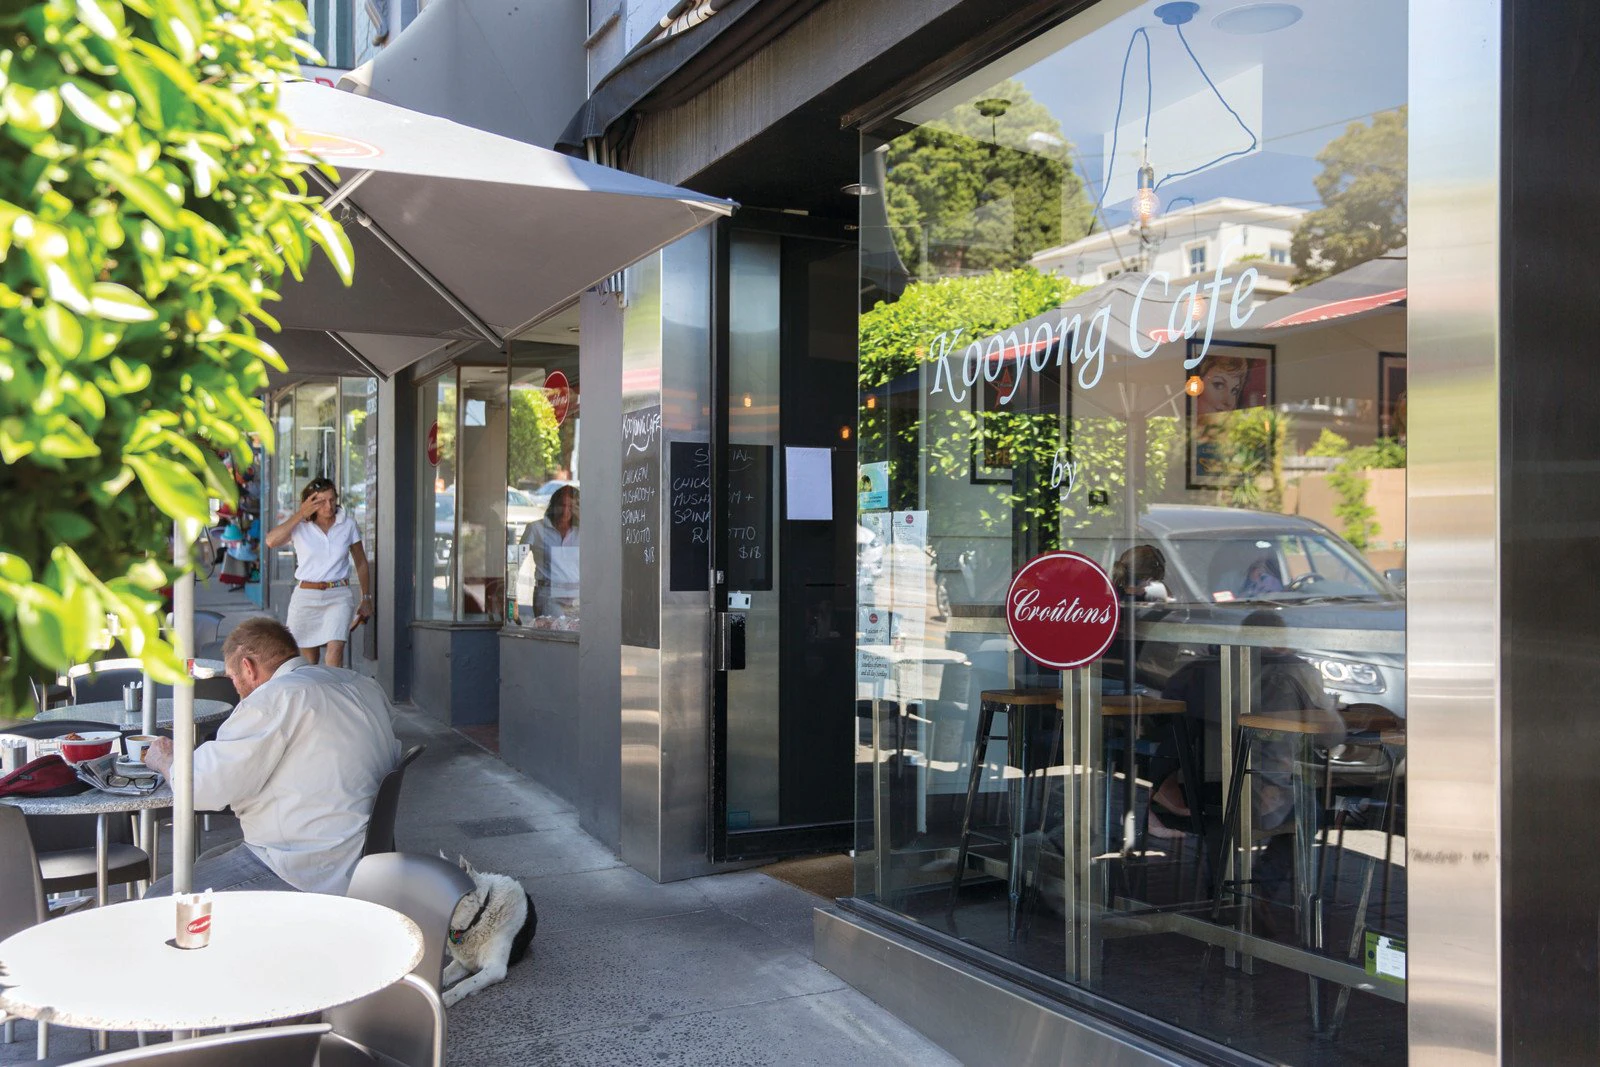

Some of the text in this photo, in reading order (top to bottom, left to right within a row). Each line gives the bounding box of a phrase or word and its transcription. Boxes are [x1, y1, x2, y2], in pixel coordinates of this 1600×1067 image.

[930, 235, 1259, 405] Kooyong Cafe
[1051, 448, 1077, 500] by
[739, 545, 762, 560] $18
[1013, 588, 1111, 625] Croûtons
